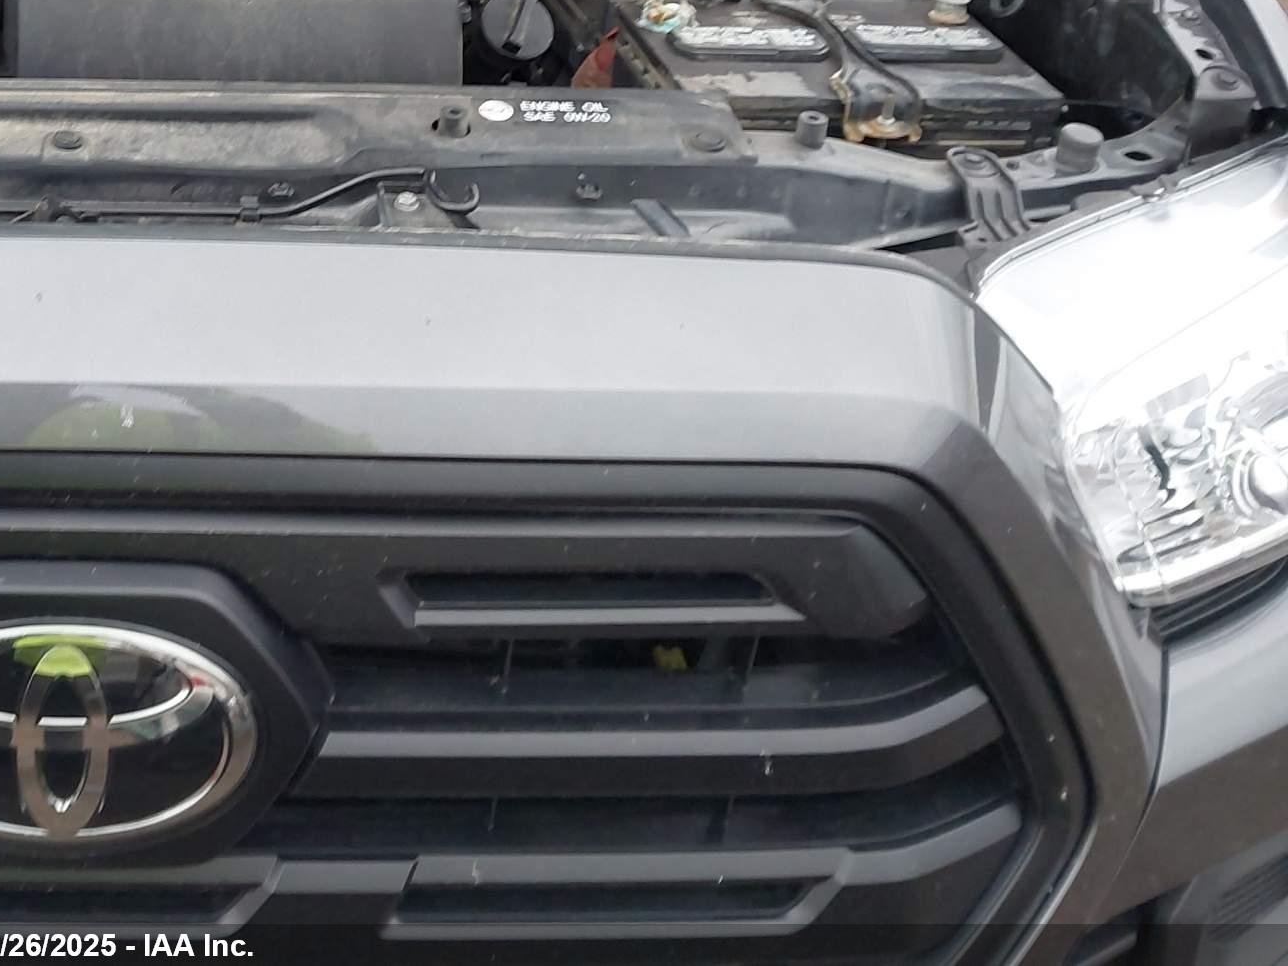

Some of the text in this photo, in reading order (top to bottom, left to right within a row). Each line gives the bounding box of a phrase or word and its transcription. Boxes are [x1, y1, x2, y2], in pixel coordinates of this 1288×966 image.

[519, 100, 609, 112] ENGINE OIL
[523, 112, 556, 122] SAE
